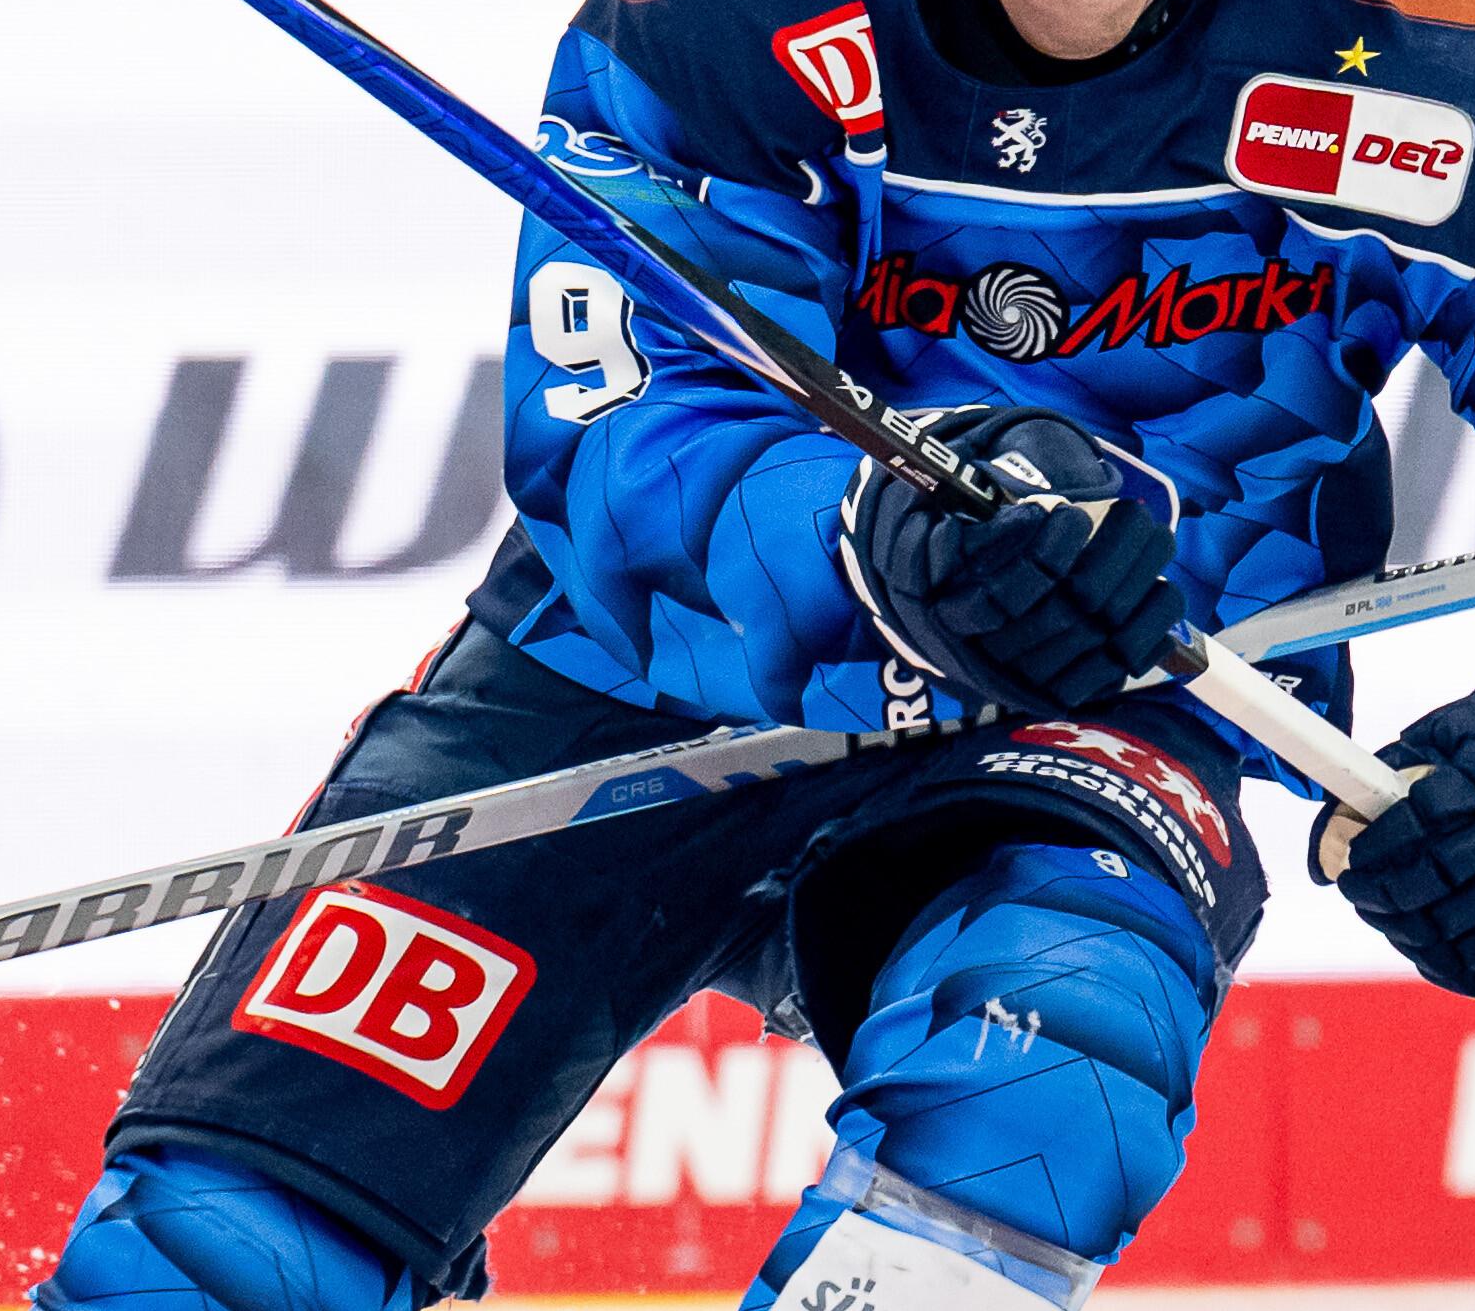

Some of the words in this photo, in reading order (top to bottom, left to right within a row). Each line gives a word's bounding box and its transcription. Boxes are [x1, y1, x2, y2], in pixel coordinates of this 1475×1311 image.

[528, 260, 652, 425] 9
[1056, 262, 1333, 356] Markt
[264, 902, 487, 1063] DB
